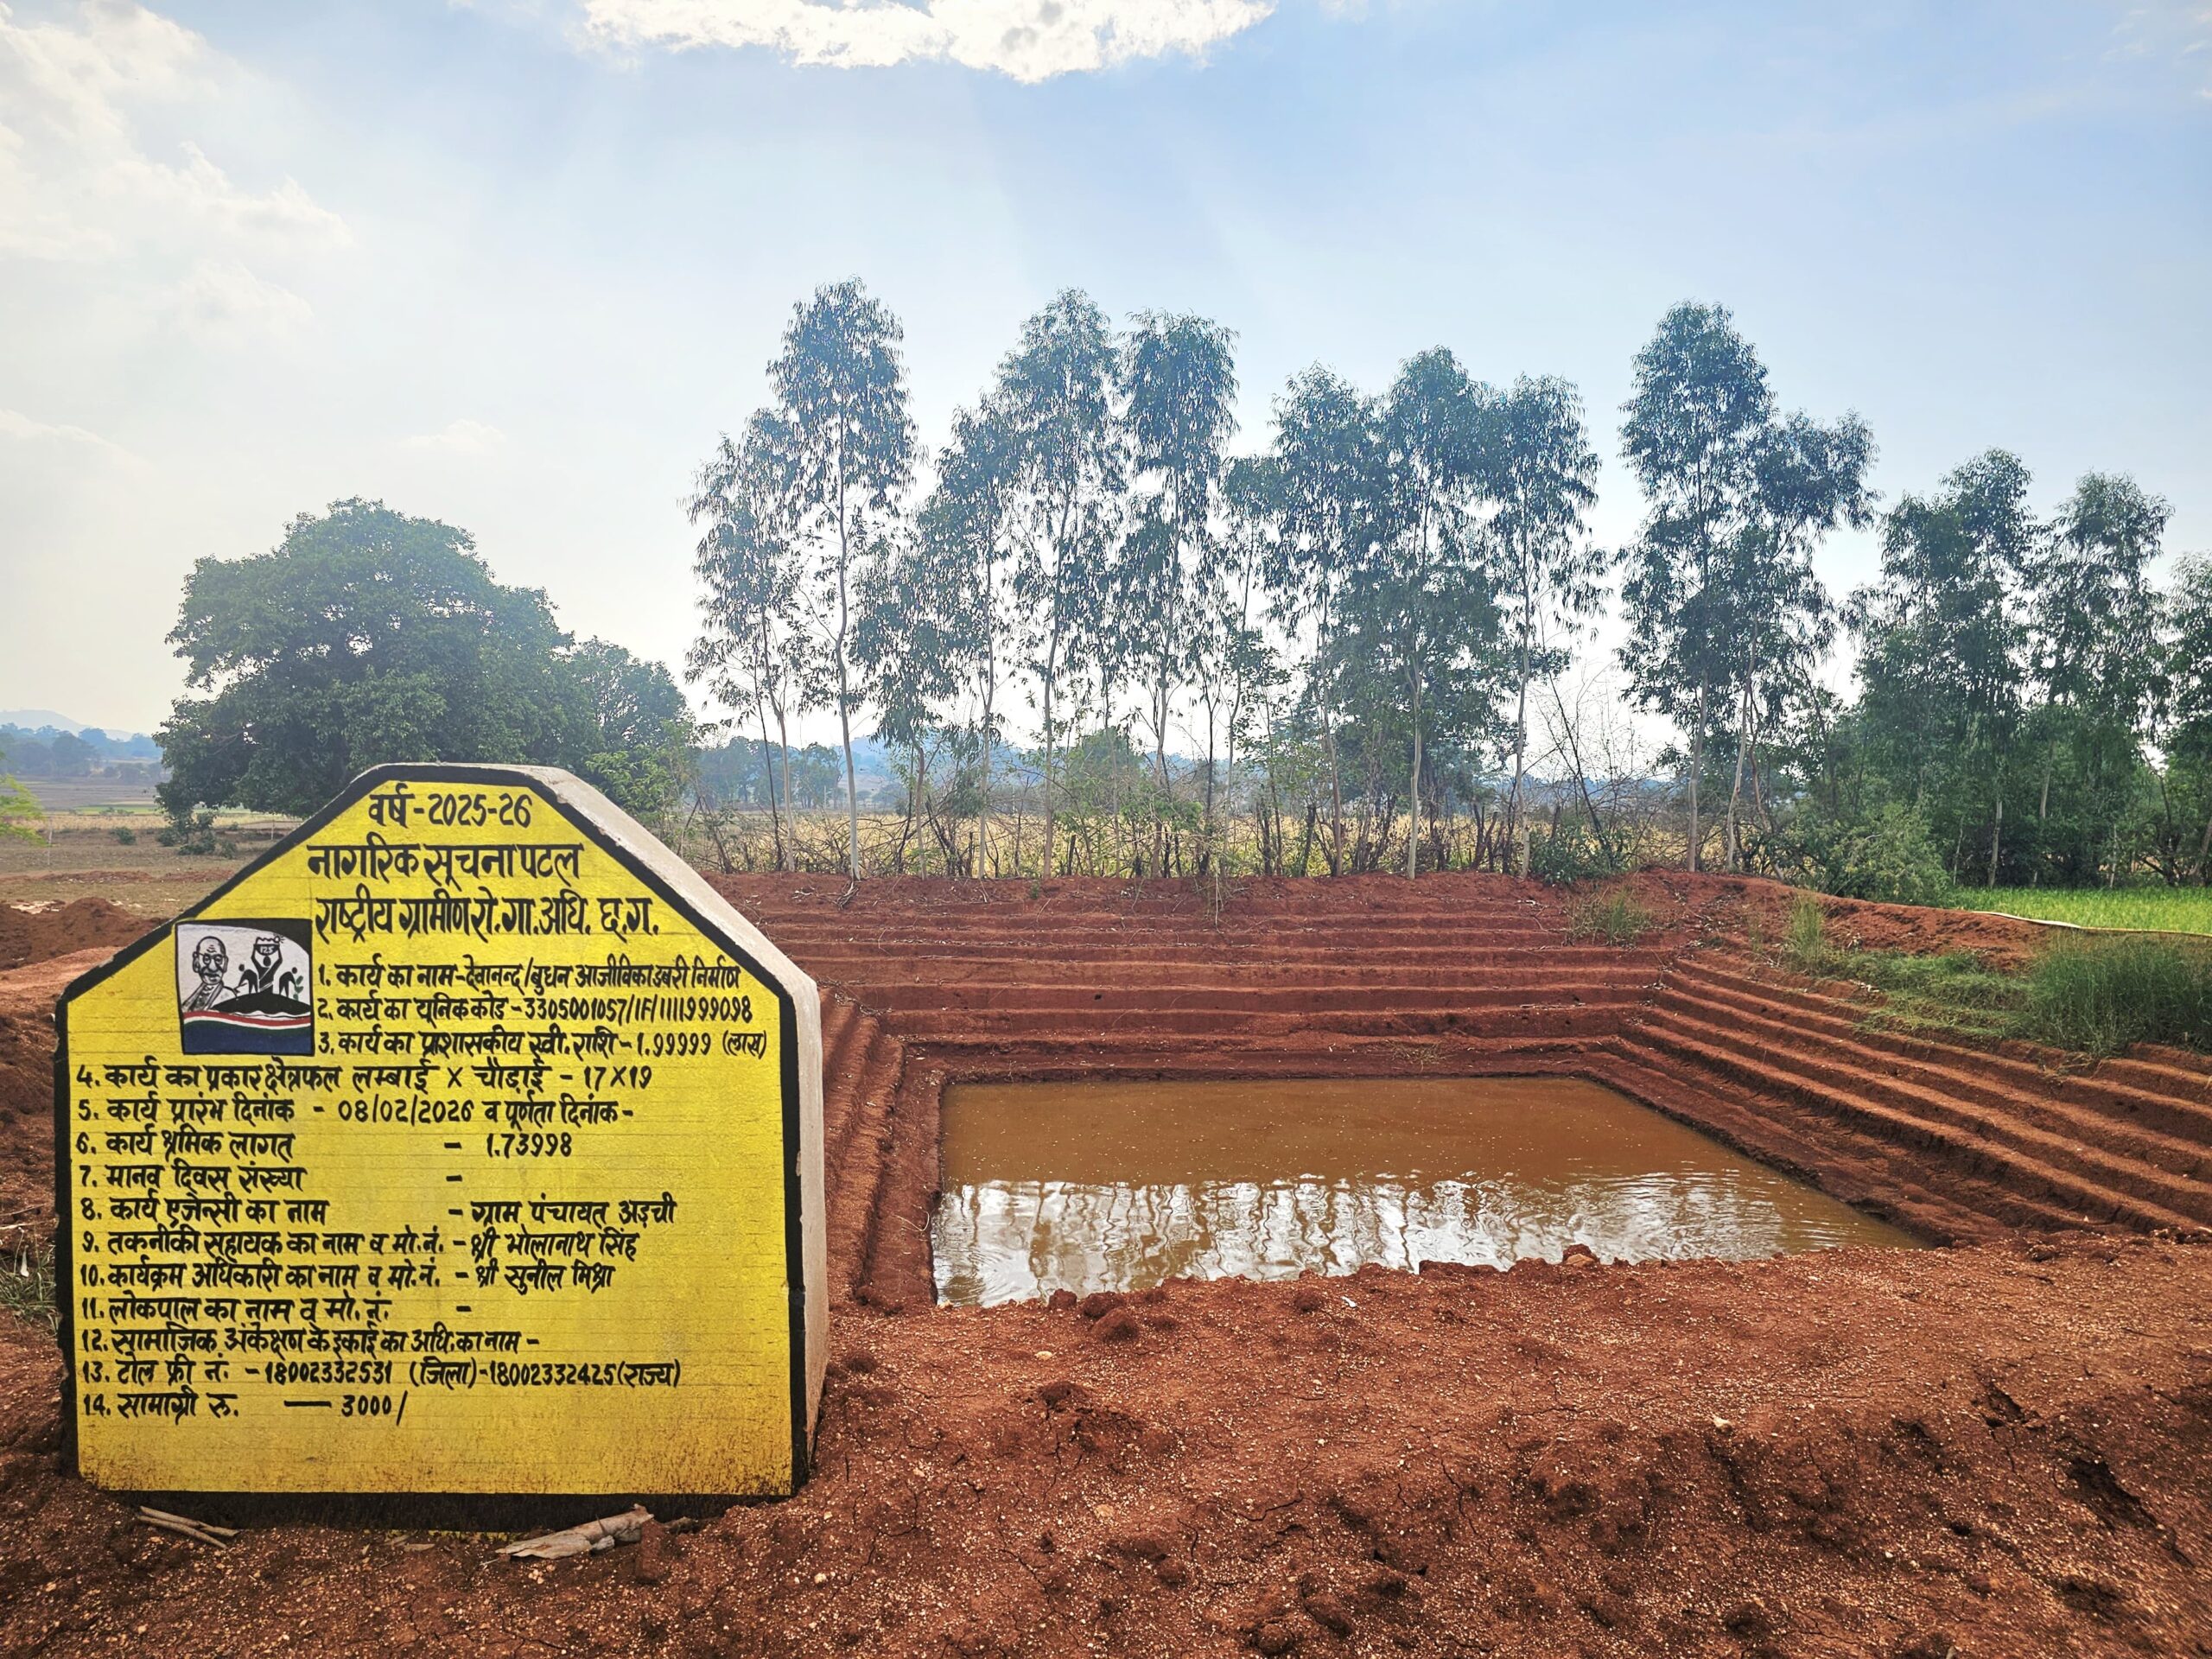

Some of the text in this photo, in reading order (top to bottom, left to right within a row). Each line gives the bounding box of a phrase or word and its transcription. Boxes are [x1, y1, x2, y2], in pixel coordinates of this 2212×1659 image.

[306, 831, 585, 892] नागरिक सूचना पटल
[315, 882, 397, 944] राष्ट्रीय
[398, 887, 472, 938] ग्रामीण
[318, 963, 331, 987] 1.
[334, 952, 386, 988] कार्य
[387, 963, 415, 988] का
[575, 953, 655, 988] आजीविका
[652, 954, 691, 989] डबरी
[690, 954, 741, 989] निर्माण
[317, 997, 334, 1020] 2.
[335, 988, 384, 1021] कार्य
[384, 997, 412, 1020] का
[470, 989, 510, 1020] कोड
[318, 1031, 334, 1055] 3.
[337, 1023, 384, 1055] कार्य
[383, 1031, 416, 1055] का
[76, 1064, 100, 1089] 4.
[103, 1055, 162, 1089] कार्य
[162, 1065, 203, 1088] का
[202, 1065, 264, 1092] प्रकार
[352, 1058, 441, 1095] लम्बाई
[78, 1098, 99, 1122] 5.
[106, 1090, 162, 1122] कार्य
[165, 1090, 228, 1126] प्रारंभ
[231, 1090, 295, 1128] दिनांक
[338, 1093, 474, 1127] 08/02/2026
[481, 1100, 502, 1123] व
[504, 1087, 556, 1132] पूर्णता
[75, 1131, 97, 1154] 6.
[105, 1122, 158, 1156] कार्य
[161, 1122, 225, 1162] श्रमिक
[227, 1131, 296, 1164] लागत
[486, 1132, 572, 1159] 1.73998
[79, 1165, 98, 1188] 7.
[104, 1164, 166, 1189] मानव
[170, 1157, 232, 1195] दिवस
[237, 1160, 308, 1194] संख्या
[80, 1197, 102, 1221] 8.
[109, 1187, 161, 1223] कार्य
[163, 1191, 243, 1229] एजेन्सी
[245, 1198, 281, 1224] का
[283, 1198, 331, 1226] नाम
[470, 1200, 523, 1228] ग्राम
[527, 1192, 610, 1230] पंचायत
[81, 1230, 99, 1253] 9.
[107, 1223, 202, 1255] तकनीकी
[203, 1230, 283, 1264] सहायक
[286, 1231, 320, 1255] का
[321, 1232, 365, 1256] नाम
[369, 1233, 390, 1255] व
[470, 1226, 501, 1264] श्री
[504, 1223, 596, 1262] भोलानाथ
[598, 1226, 641, 1262] सिंह
[192, 1255, 283, 1293] अधिकारी
[285, 1264, 317, 1289] का
[317, 1264, 361, 1290] नाम
[367, 1265, 384, 1288] व
[475, 1257, 499, 1288] श्री
[504, 1257, 568, 1296] सुनील
[570, 1258, 617, 1294] मिश्रा
[107, 1289, 202, 1325] लोकपाल
[203, 1298, 242, 1323] का
[244, 1299, 296, 1324] नाम
[299, 1297, 319, 1323] व
[111, 1320, 218, 1355] सामाजिक
[306, 1321, 331, 1352] के
[331, 1319, 380, 1361] इकाई
[379, 1329, 410, 1353] का
[484, 1331, 522, 1355] नाम
[82, 1360, 111, 1384] 13.
[114, 1351, 160, 1386] टोल
[164, 1352, 197, 1387] फ्री
[83, 1393, 111, 1417] 14.
[117, 1384, 200, 1426] सामाग्री
